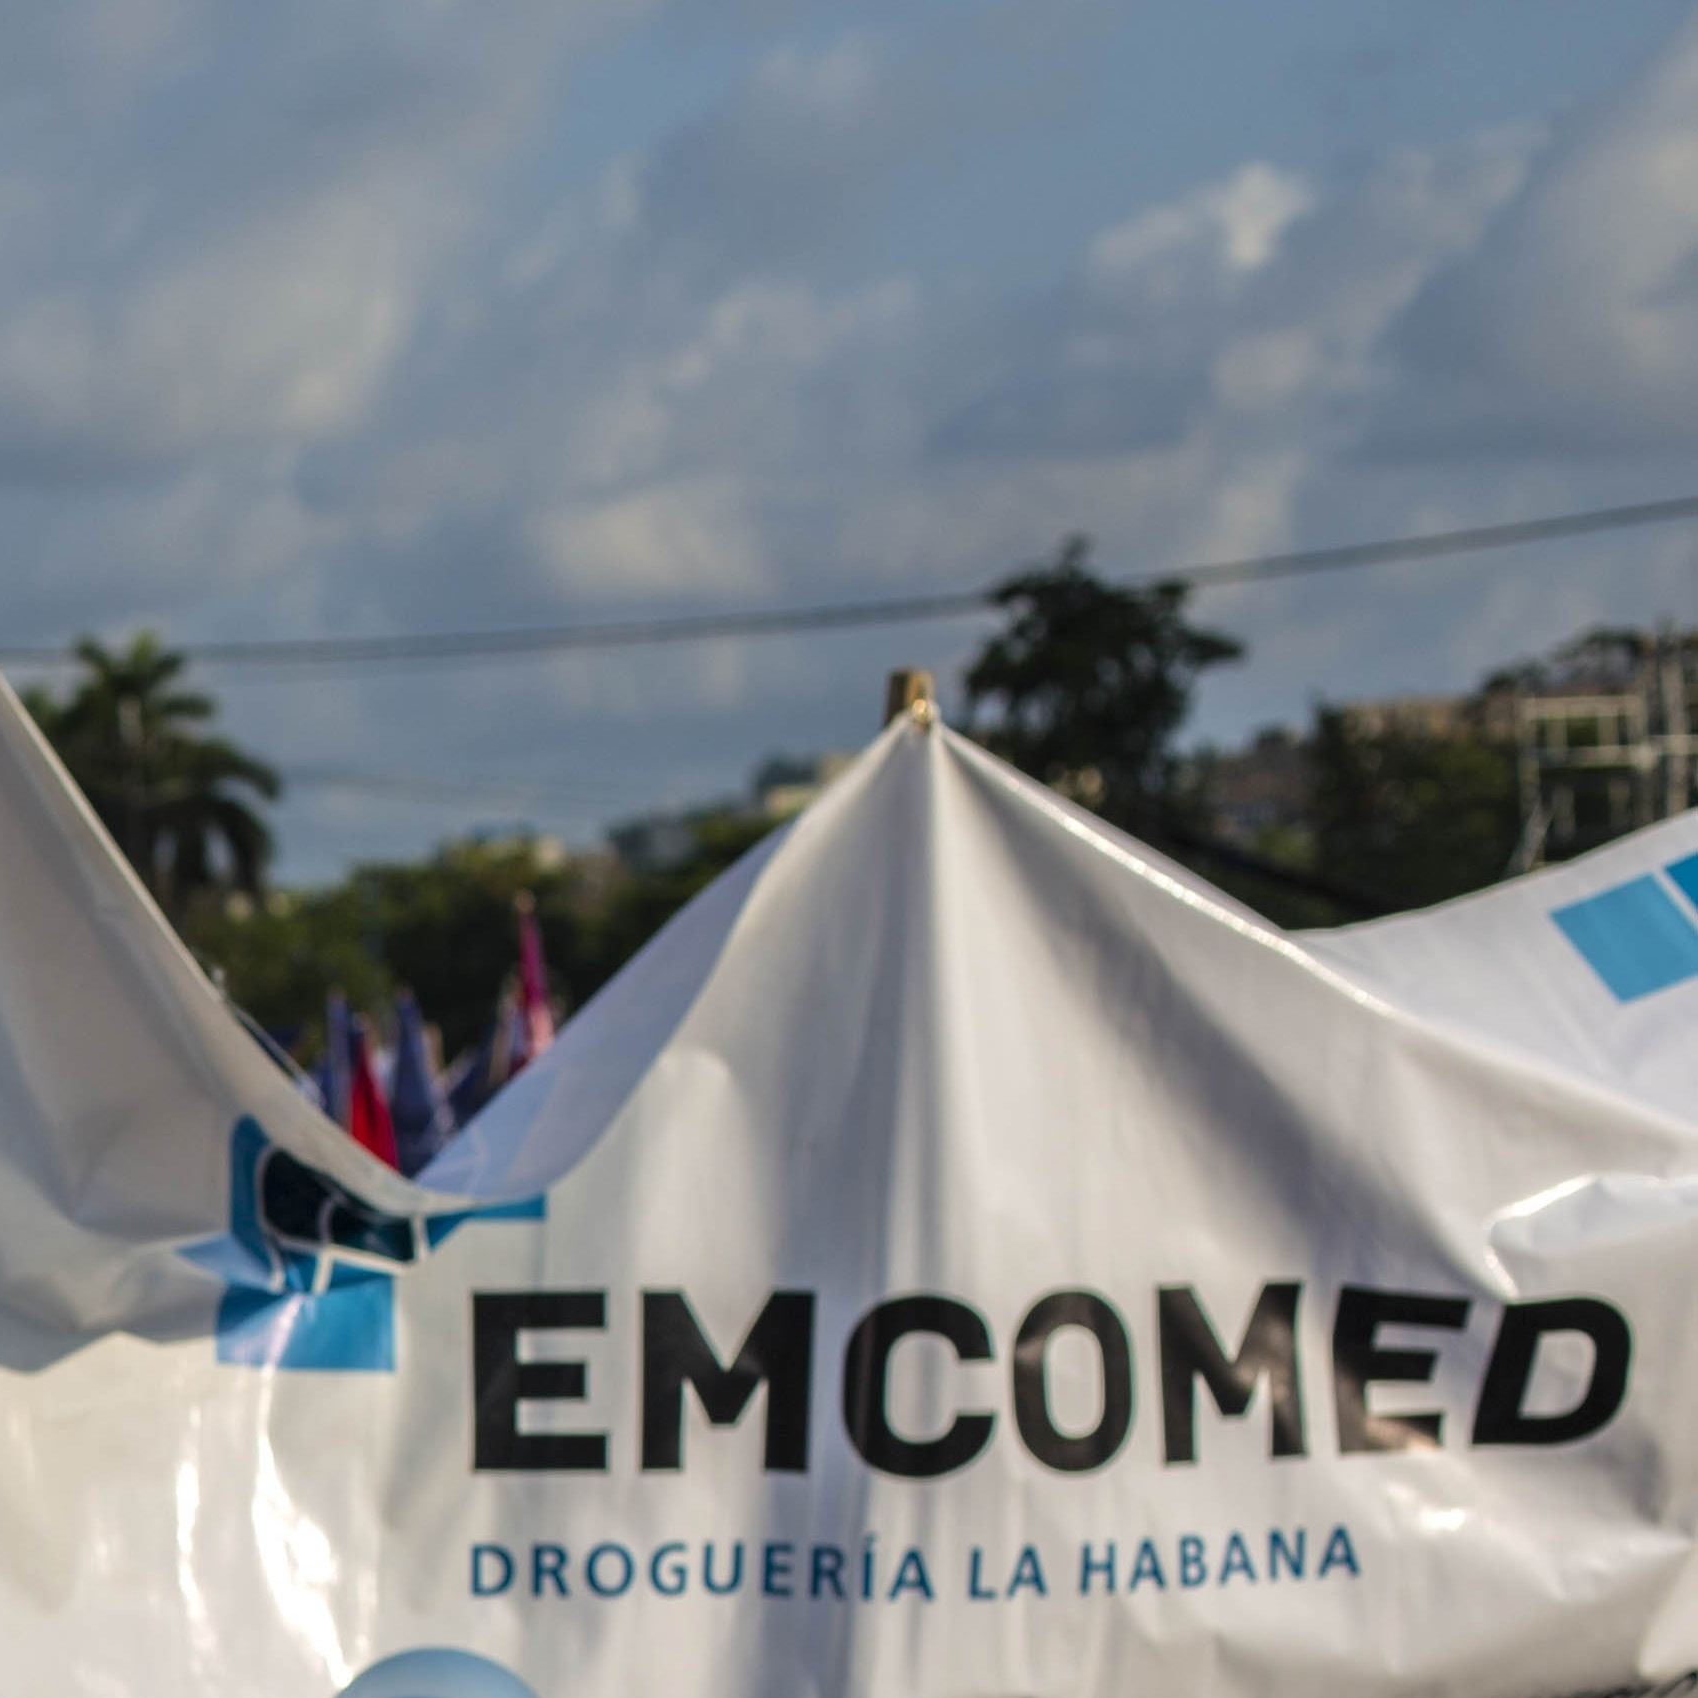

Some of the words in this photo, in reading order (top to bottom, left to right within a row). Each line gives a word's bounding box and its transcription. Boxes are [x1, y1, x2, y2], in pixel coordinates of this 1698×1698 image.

[471, 1279, 1633, 1479] EMCOMED
[471, 1532, 935, 1600] DROGUERÍA
[967, 1545, 1048, 1600] LA
[1079, 1524, 1362, 1597] HABANA
